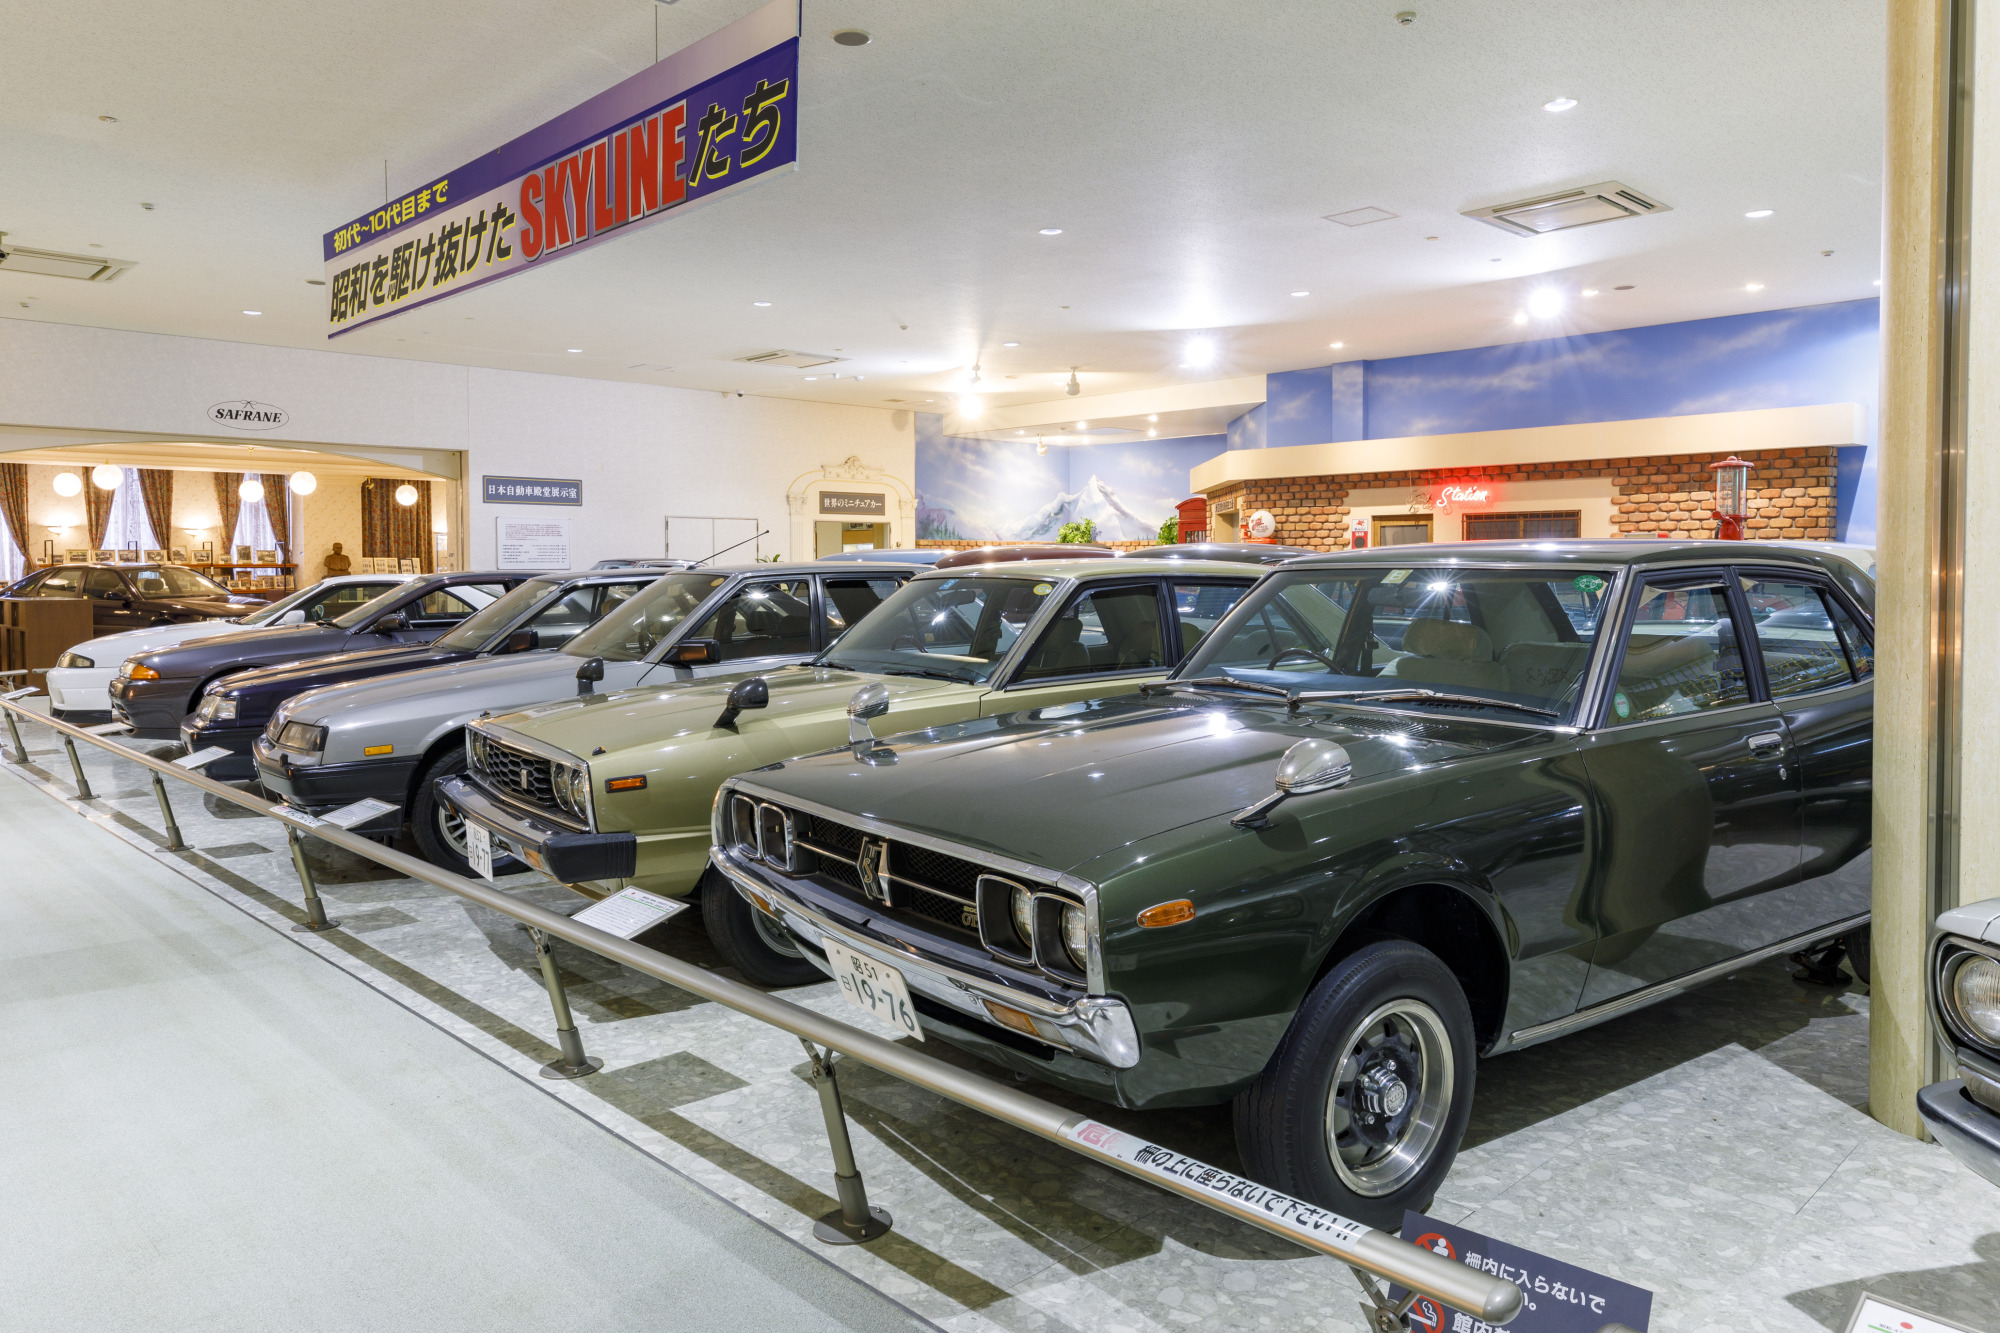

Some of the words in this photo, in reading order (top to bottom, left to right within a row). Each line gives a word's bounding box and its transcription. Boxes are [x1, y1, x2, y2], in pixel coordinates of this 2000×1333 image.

[330, 201, 517, 325] 昭和を駆け抜けた
[520, 99, 688, 263] SKYLINE
[688, 77, 790, 188] たち
[215, 408, 282, 423] SAFRANE
[488, 484, 578, 499] 日本自動車殿堂展示室
[1436, 486, 1488, 507] Station
[824, 498, 882, 509] 世界のミニチュアカー
[850, 955, 879, 981] 昭51
[851, 973, 915, 1032] 19-76
[1464, 1250, 1606, 1315] 柵内に入らないで
